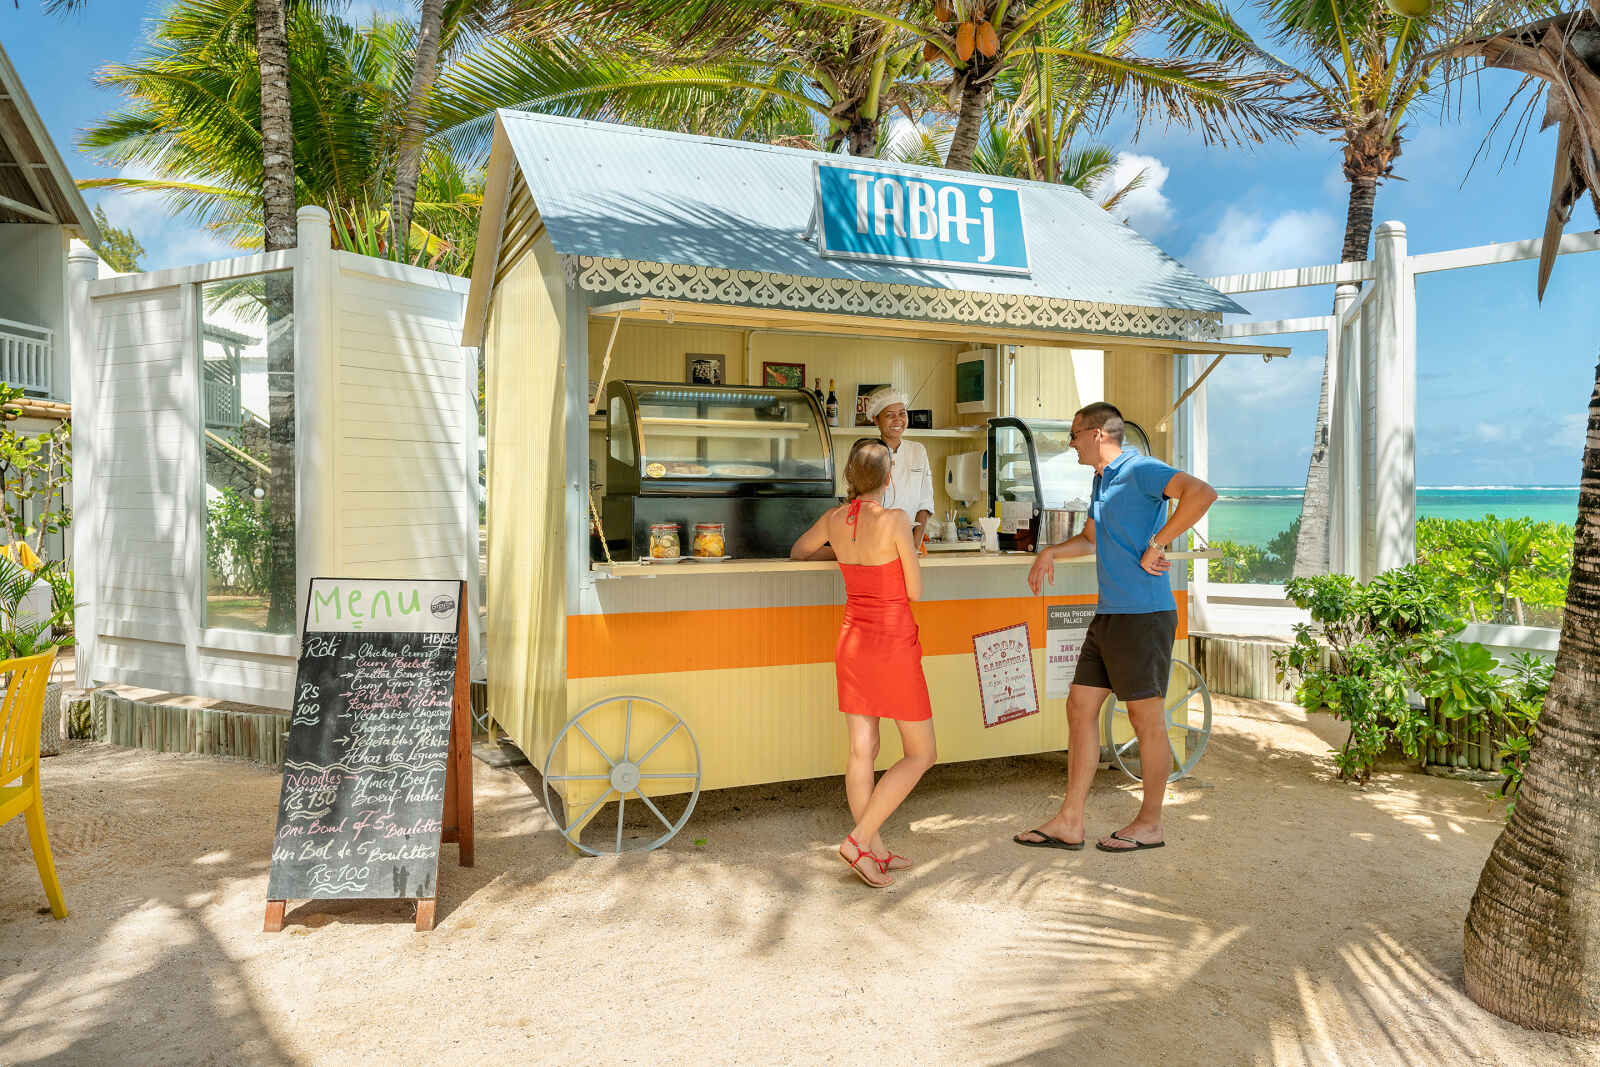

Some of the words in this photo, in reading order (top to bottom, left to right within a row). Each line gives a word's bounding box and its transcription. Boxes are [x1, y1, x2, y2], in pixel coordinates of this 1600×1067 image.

[314, 586, 421, 624] Menu
[1063, 617, 1083, 625] PALACE
[359, 643, 397, 658] Chicken
[296, 703, 320, 716] 100
[308, 790, 336, 808] 150
[279, 825, 305, 839] One
[373, 813, 395, 831] 5
[337, 863, 370, 882] 100
